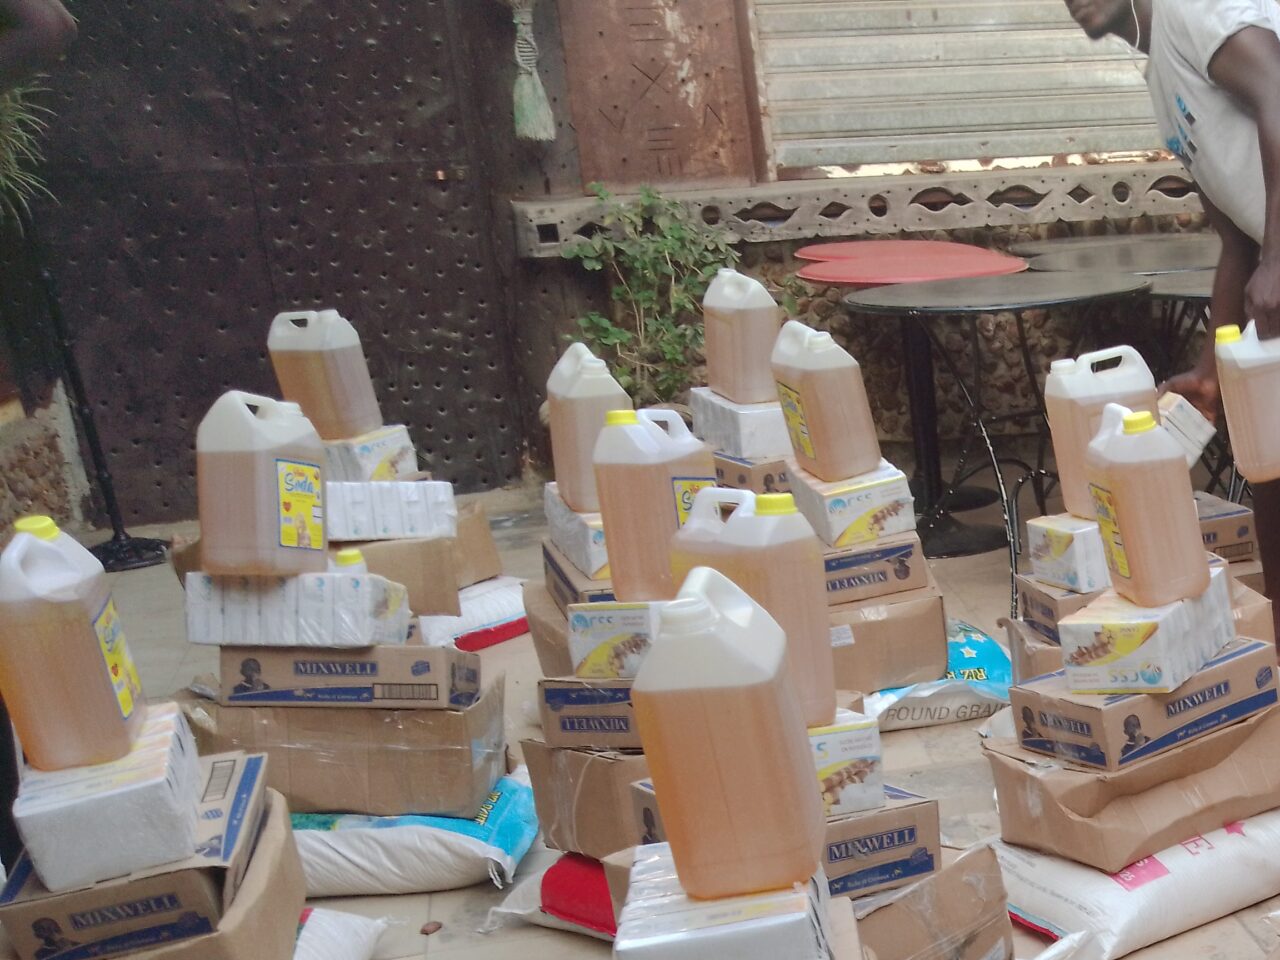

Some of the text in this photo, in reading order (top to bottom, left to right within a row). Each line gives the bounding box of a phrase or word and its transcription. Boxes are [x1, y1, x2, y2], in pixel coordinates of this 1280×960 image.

[299, 662, 378, 676] MIXWELL
[1167, 683, 1228, 716] MIXWELL
[885, 706, 950, 722] ROUND
[565, 717, 628, 731] MIXWELL
[75, 896, 177, 929] MIXWELL
